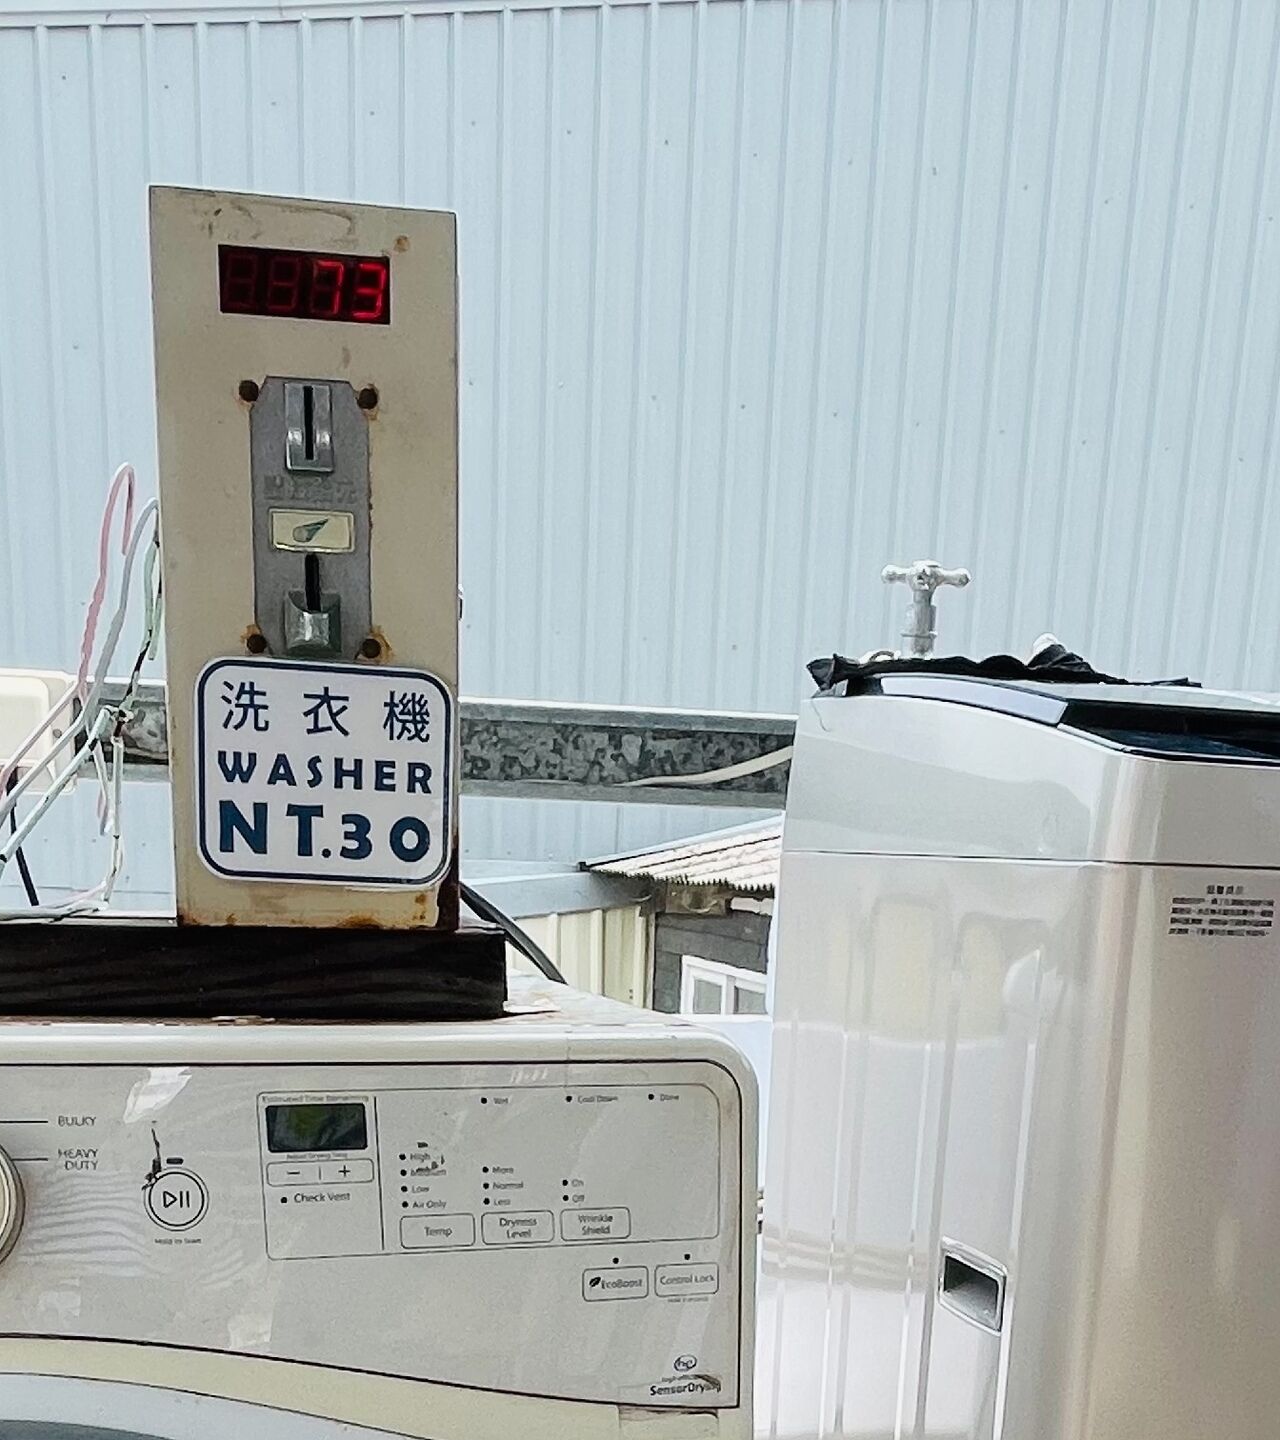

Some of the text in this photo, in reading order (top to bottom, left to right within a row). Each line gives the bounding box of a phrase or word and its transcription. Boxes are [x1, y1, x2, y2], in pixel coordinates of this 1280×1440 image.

[220, 681, 430, 743] 洗衣機
[217, 750, 432, 794] WASHER
[219, 800, 431, 862] NT.30
[58, 1115, 97, 1127] BULKY
[58, 1148, 98, 1159] HEAVY
[64, 1160, 98, 1171] DUTY
[294, 1192, 351, 1203] Check Vent
[499, 1217, 537, 1228] Dryness
[424, 1226, 453, 1238] Temp
[506, 1228, 532, 1239] Level
[582, 1226, 611, 1236] Shield
[660, 1273, 693, 1285] Control
[650, 1381, 721, 1397] SensorDry
